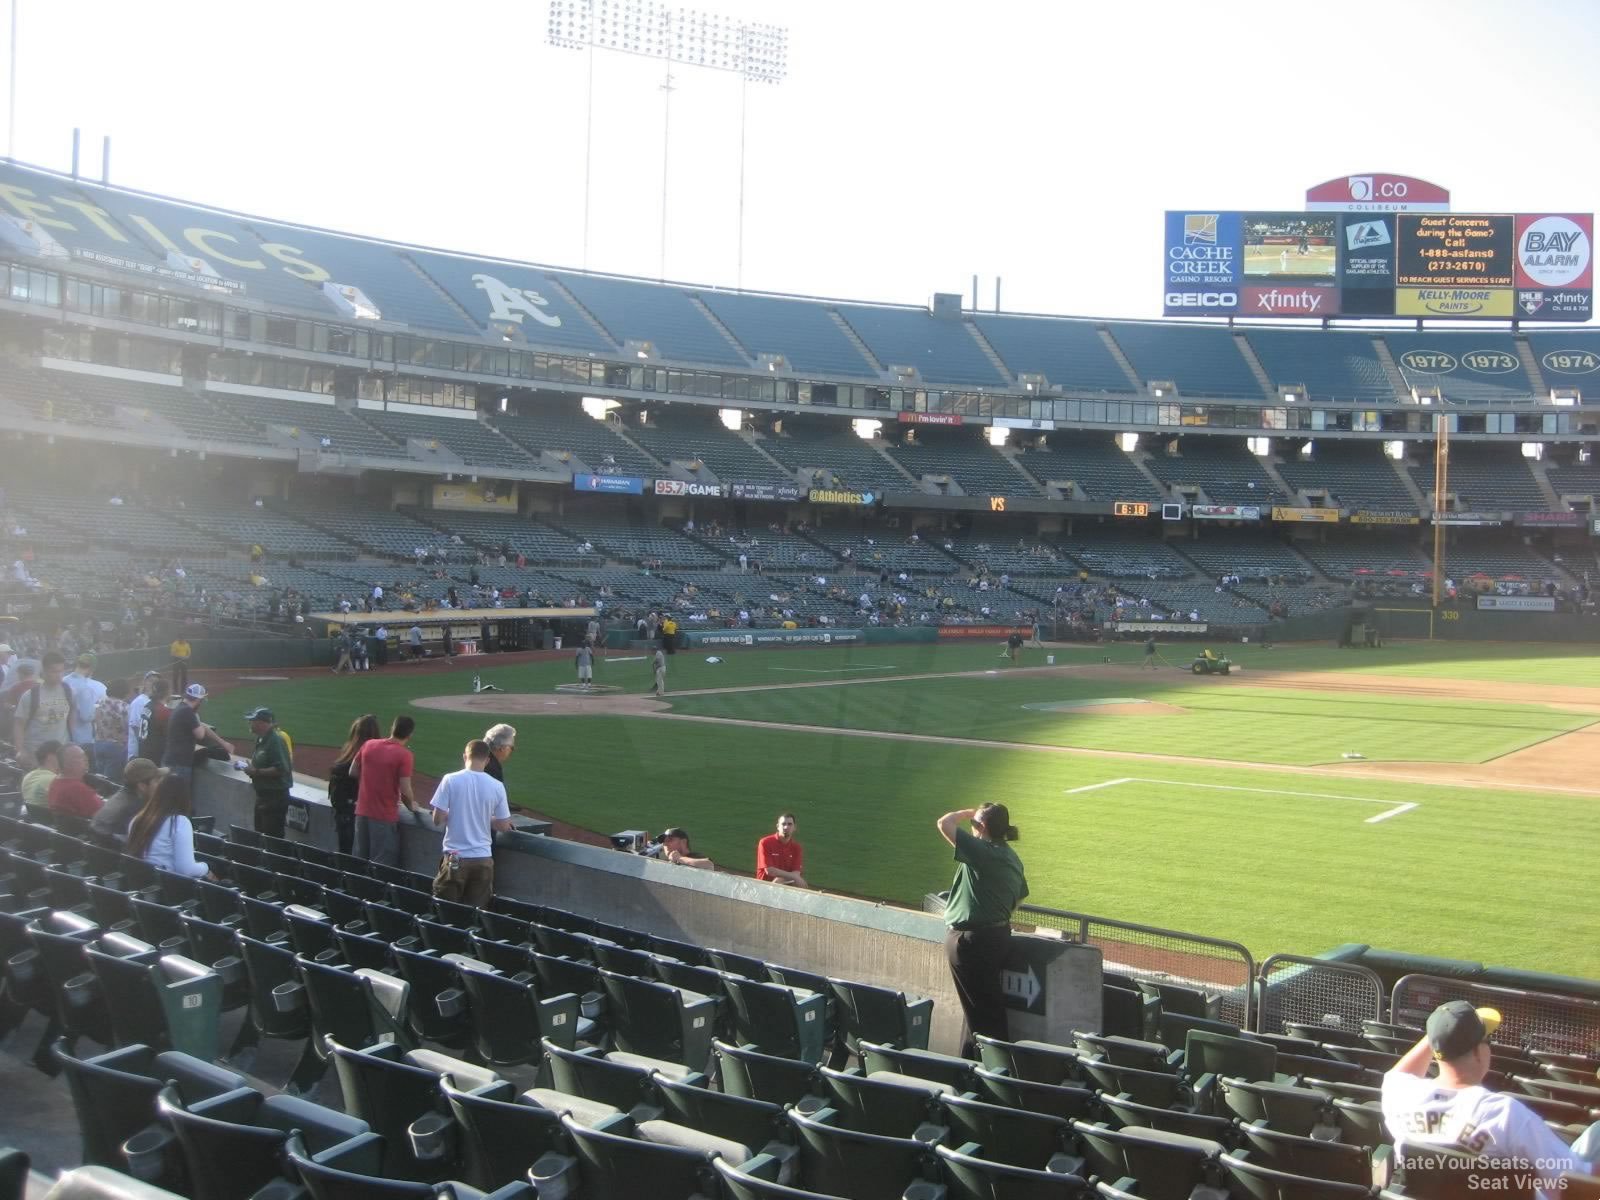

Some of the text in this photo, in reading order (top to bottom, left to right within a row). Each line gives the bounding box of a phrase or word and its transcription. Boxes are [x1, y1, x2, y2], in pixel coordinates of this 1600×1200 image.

[1421, 218, 1489, 226] Guest Concerns
[1416, 228, 1494, 238] during the Game?
[1525, 232, 1583, 252] BAY
[1169, 246, 1232, 260] CACHE
[1524, 255, 1579, 266] ALARM
[1169, 261, 1232, 274] CREEK
[1428, 262, 1485, 271] (273-2670)
[196, 276, 218, 286] LOCATION
[1166, 292, 1237, 306] GEICO
[1418, 290, 1490, 300] KELLY-MOORE
[1553, 293, 1588, 304] xfinity
[1258, 290, 1322, 312] xfinity
[1406, 356, 1452, 368] 1972
[1468, 356, 1513, 368] 1973
[1549, 356, 1594, 368] 1974
[656, 481, 684, 494] 95.7
[689, 484, 720, 496] GAME
[778, 487, 798, 496] xfinity
[809, 489, 862, 504] @Athletics
[990, 497, 1005, 511] VS
[1121, 504, 1145, 514] 6:18
[1441, 610, 1459, 620] 330
[188, 995, 197, 1006] 10
